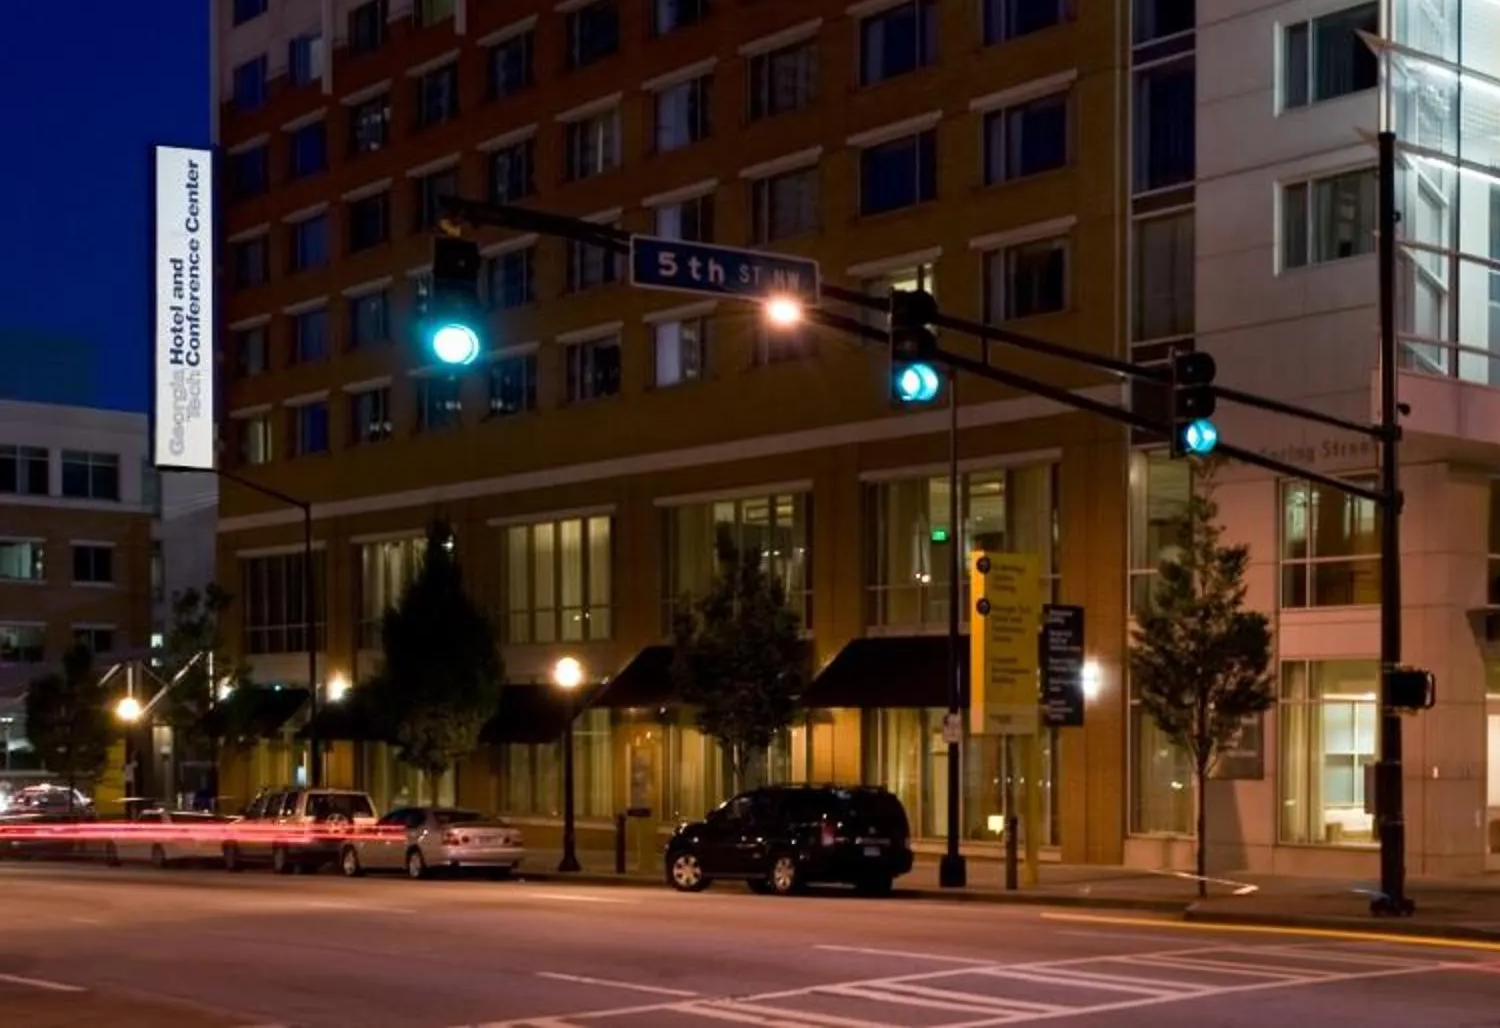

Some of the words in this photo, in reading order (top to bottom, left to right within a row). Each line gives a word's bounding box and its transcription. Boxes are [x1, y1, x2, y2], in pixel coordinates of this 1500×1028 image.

[185, 159, 199, 233] Center
[170, 257, 184, 299] and
[657, 251, 725, 284] 5th
[739, 263, 762, 284] ST
[773, 268, 800, 291] NW
[186, 239, 200, 366] Conference
[170, 306, 184, 365] Hotel
[169, 368, 187, 456] Georgia
[186, 370, 200, 421] Tech
